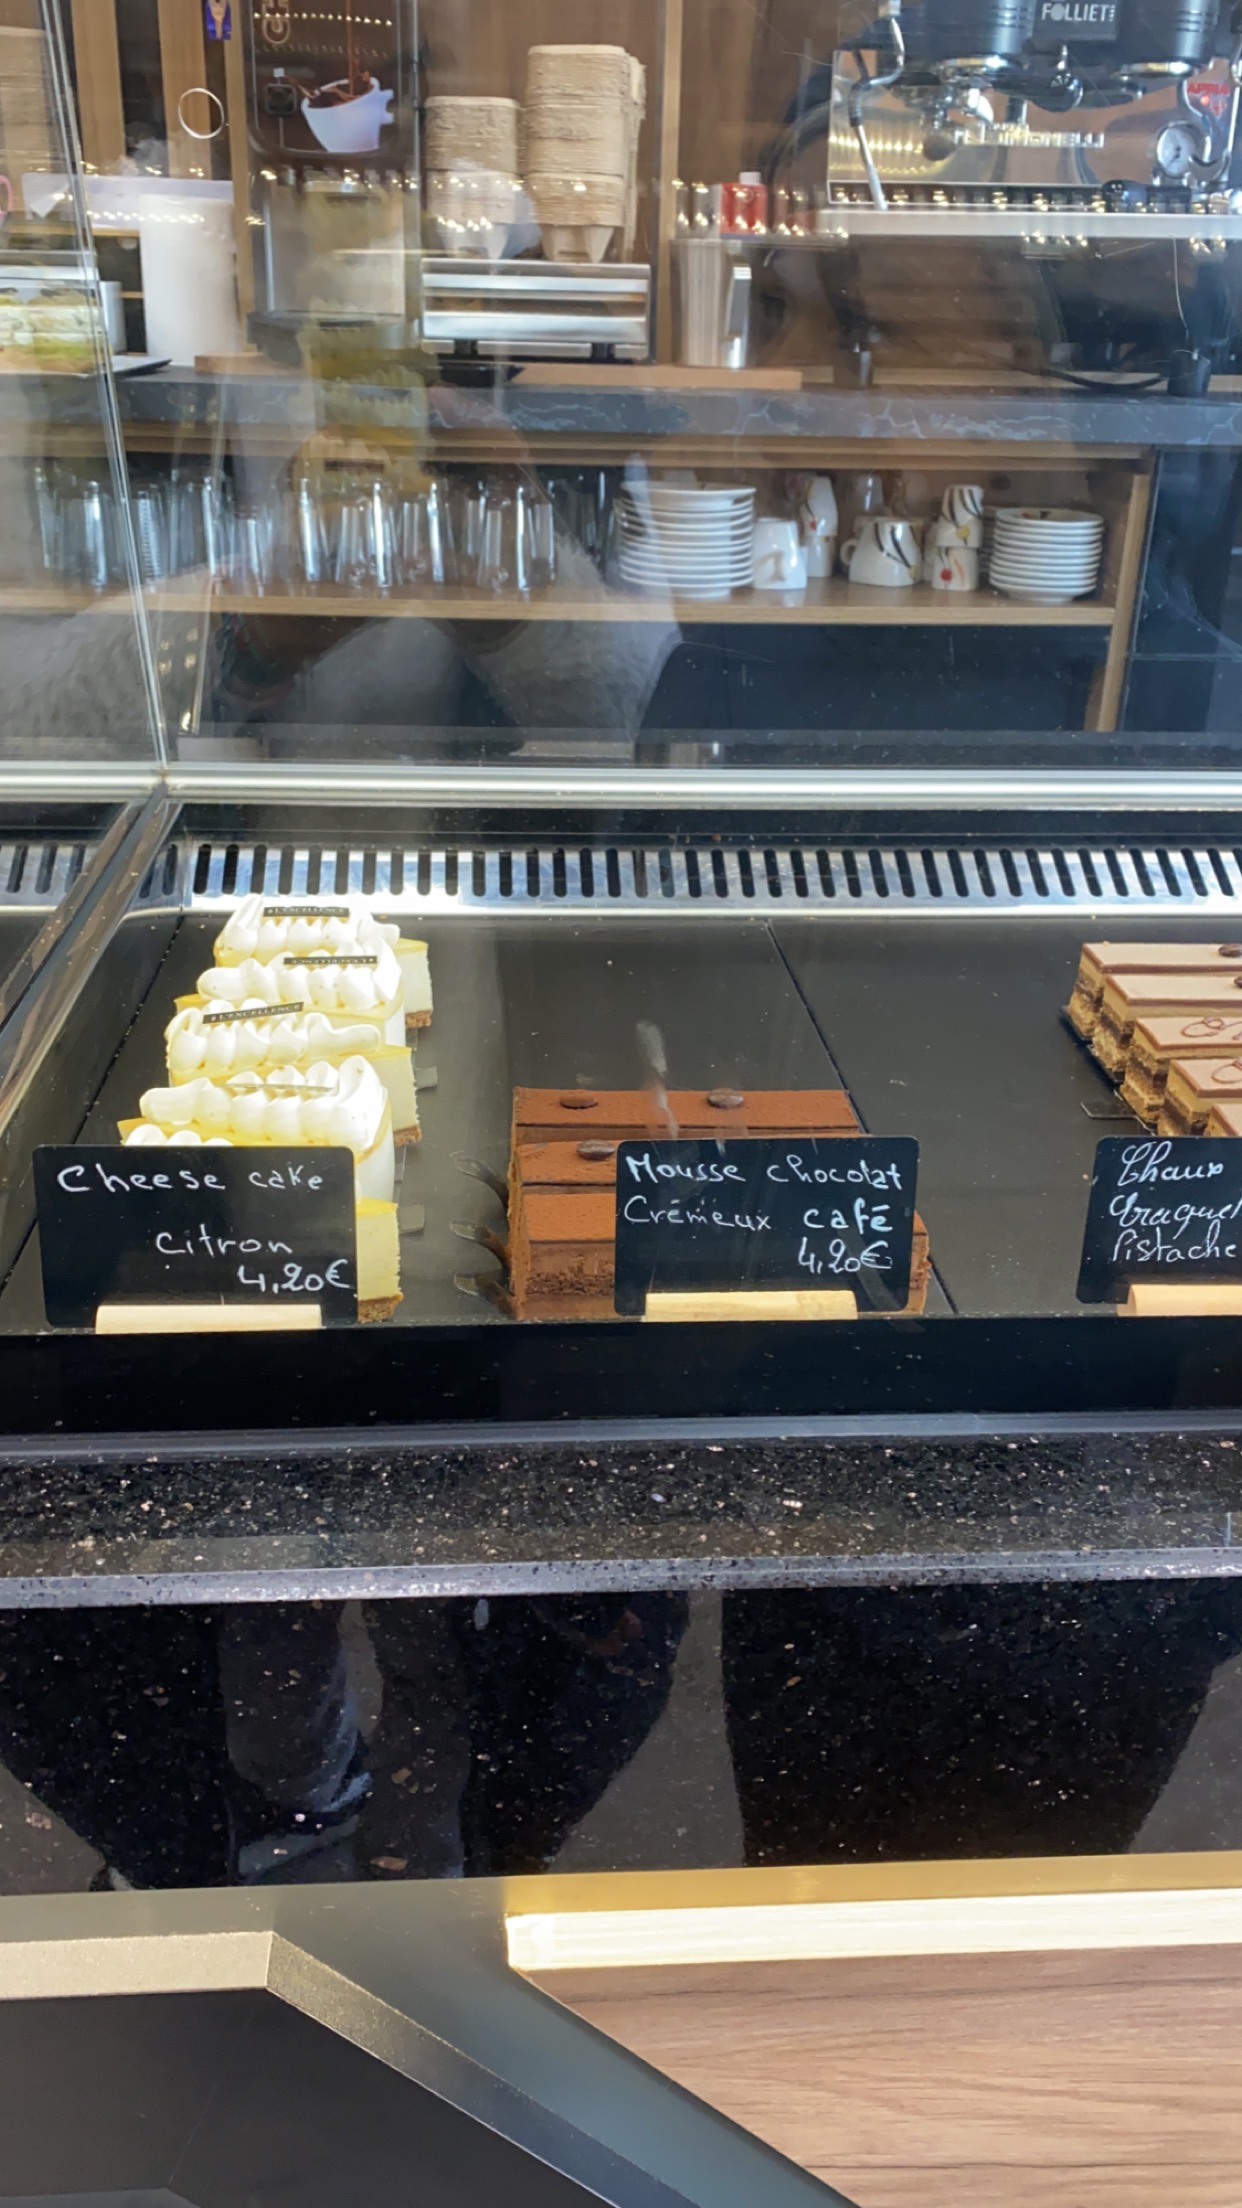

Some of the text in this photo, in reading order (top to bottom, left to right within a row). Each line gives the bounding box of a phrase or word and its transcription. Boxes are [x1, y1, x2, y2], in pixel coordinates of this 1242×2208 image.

[1041, 2, 1110, 22] FOLLIET
[57, 1163, 324, 1193] Cheese cake
[625, 1153, 746, 1184] Mousse
[803, 1197, 893, 1234] café
[798, 1237, 893, 1274] 4,20€
[237, 1259, 351, 1294] 4,20€
